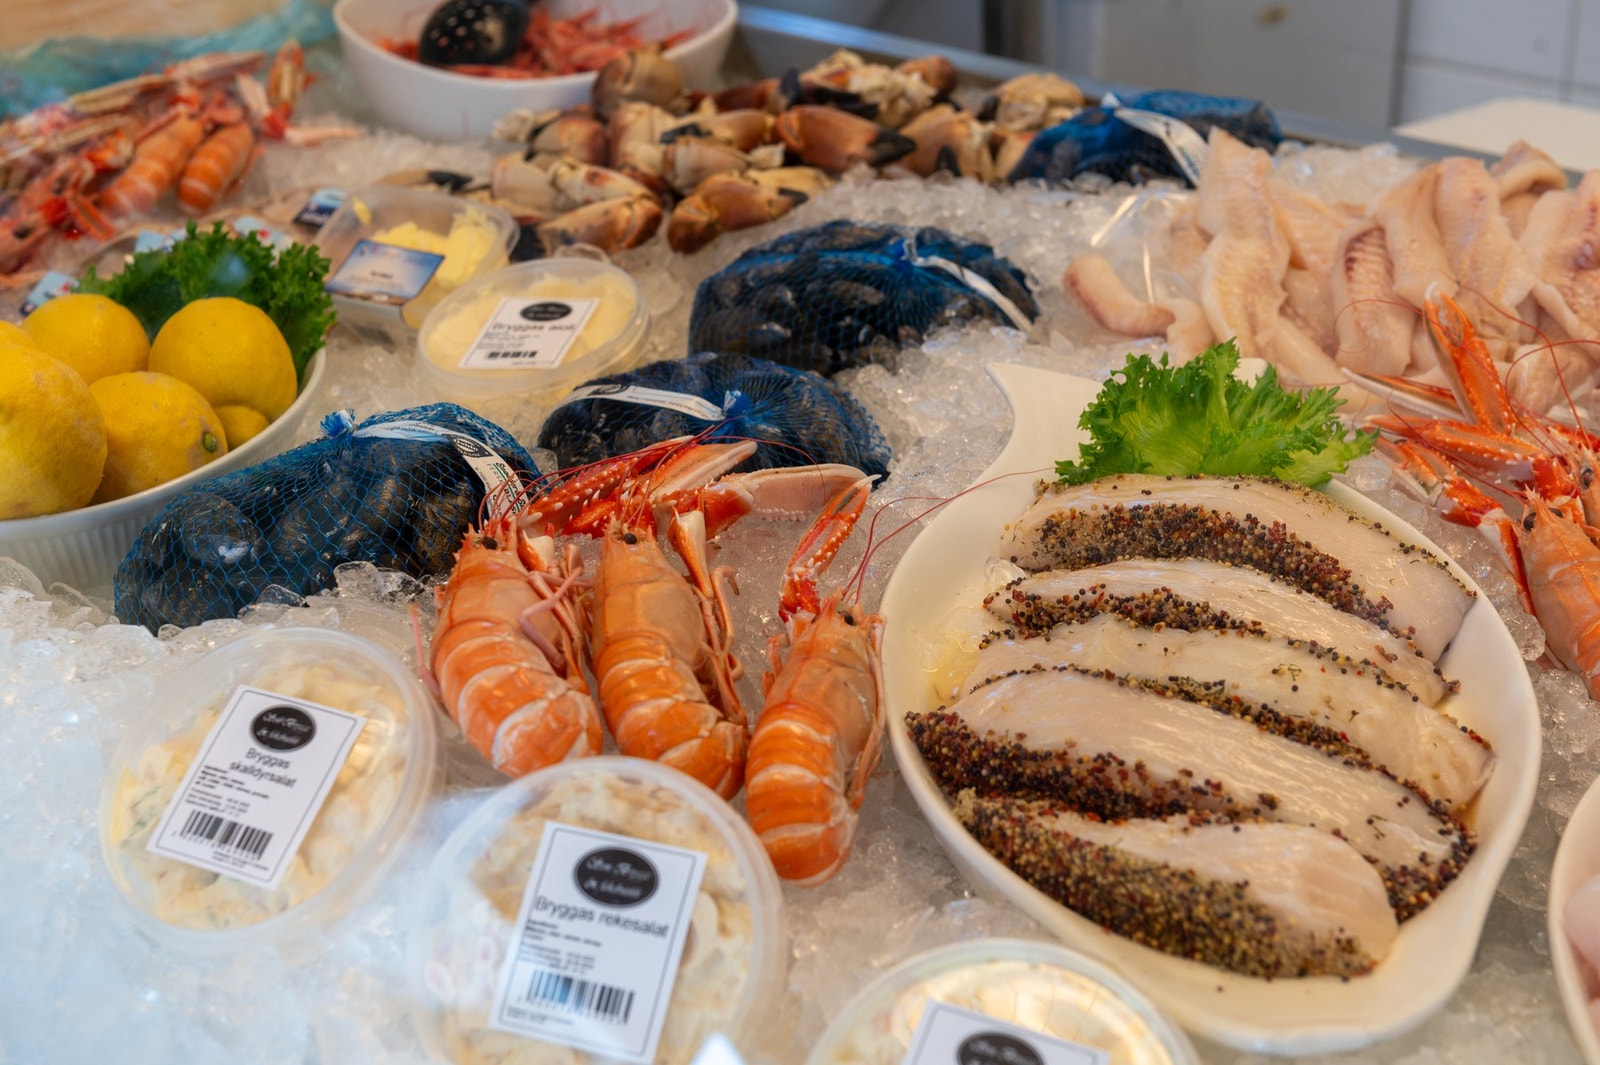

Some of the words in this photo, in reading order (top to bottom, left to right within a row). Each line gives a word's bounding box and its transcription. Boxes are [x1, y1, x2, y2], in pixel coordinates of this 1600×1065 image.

[245, 748, 290, 769] Bryggas
[535, 897, 596, 922] Bryggas
[601, 911, 669, 938] rekesalat
